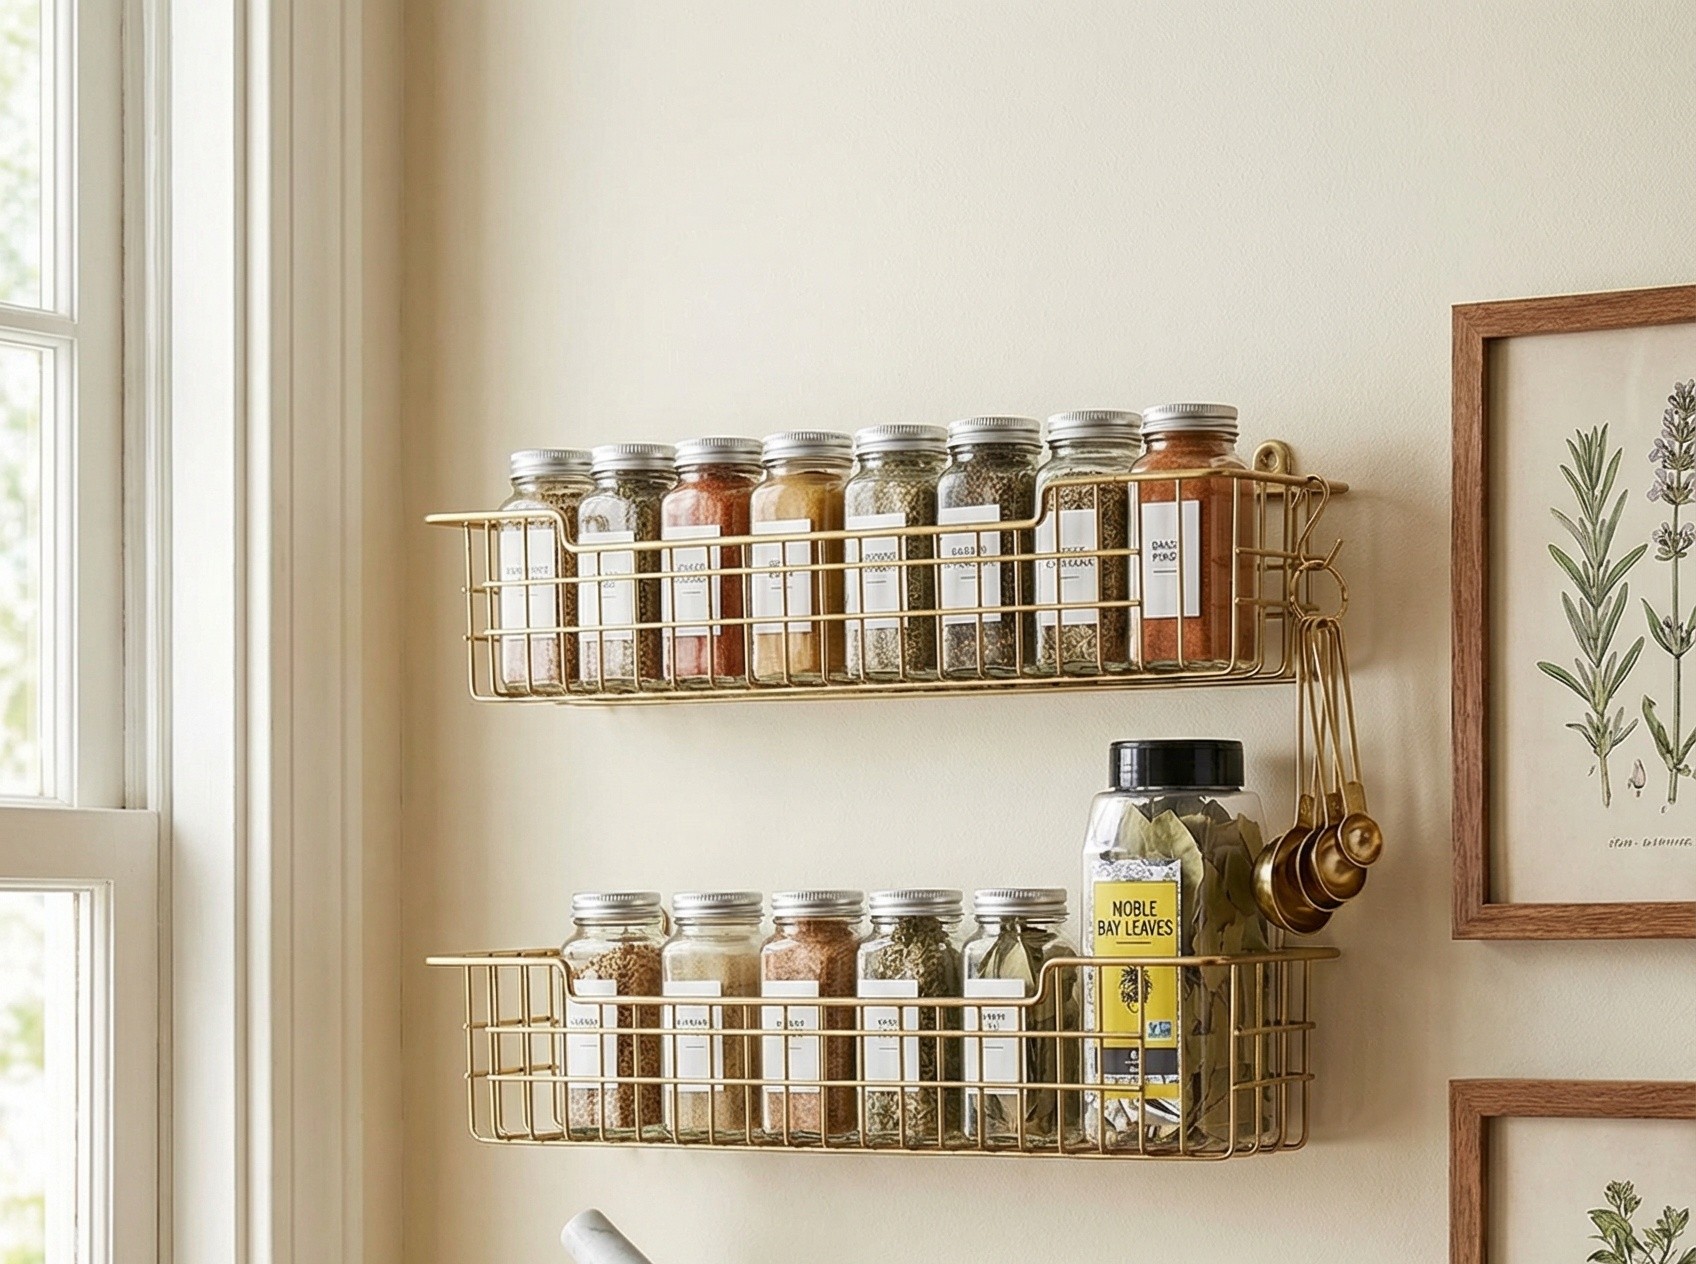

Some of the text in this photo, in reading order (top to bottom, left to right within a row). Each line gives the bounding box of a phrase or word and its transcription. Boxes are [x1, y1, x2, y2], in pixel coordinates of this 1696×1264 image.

[1112, 900, 1158, 917] NOBLE
[1098, 919, 1174, 936] BAY LEAVES
